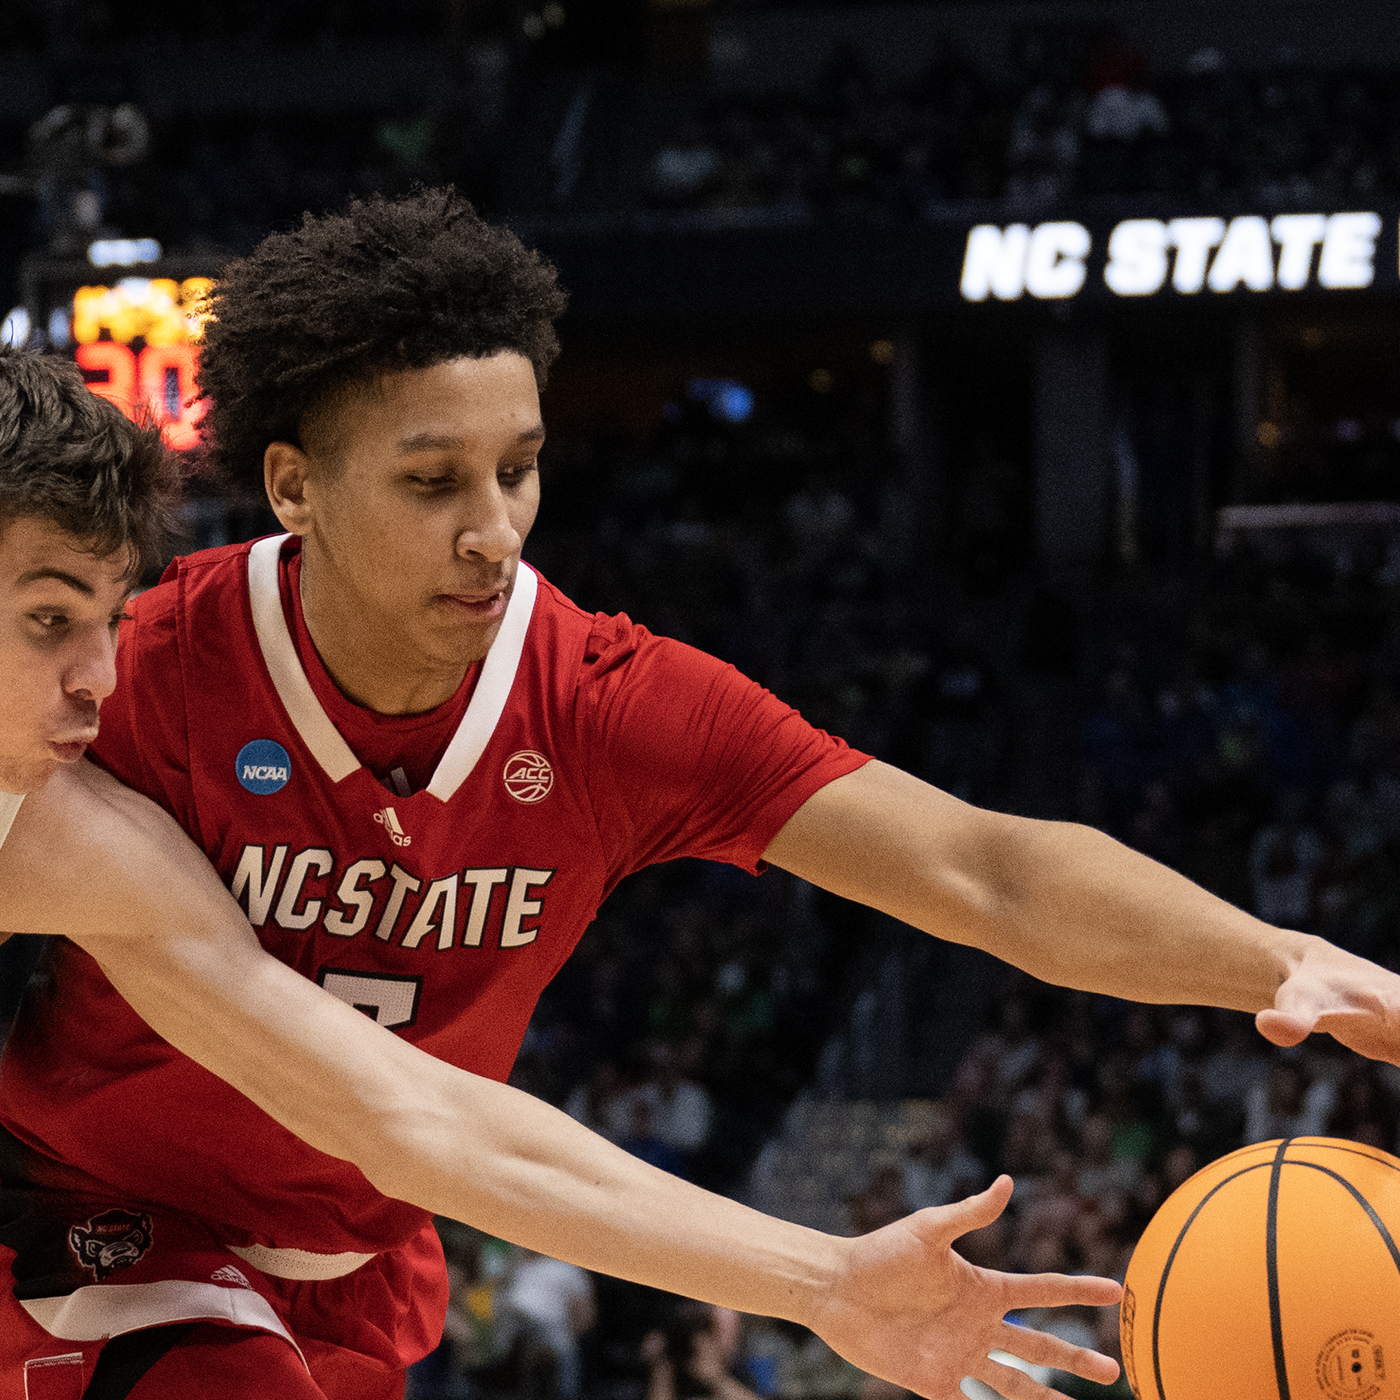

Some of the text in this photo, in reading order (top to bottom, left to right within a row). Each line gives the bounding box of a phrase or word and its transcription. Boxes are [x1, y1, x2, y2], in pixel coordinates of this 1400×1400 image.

[961, 221, 1091, 302] NC
[1104, 211, 1382, 296] STATE
[242, 764, 288, 781] NCAA
[508, 767, 552, 780] ACC
[230, 843, 558, 951] NC STATE
